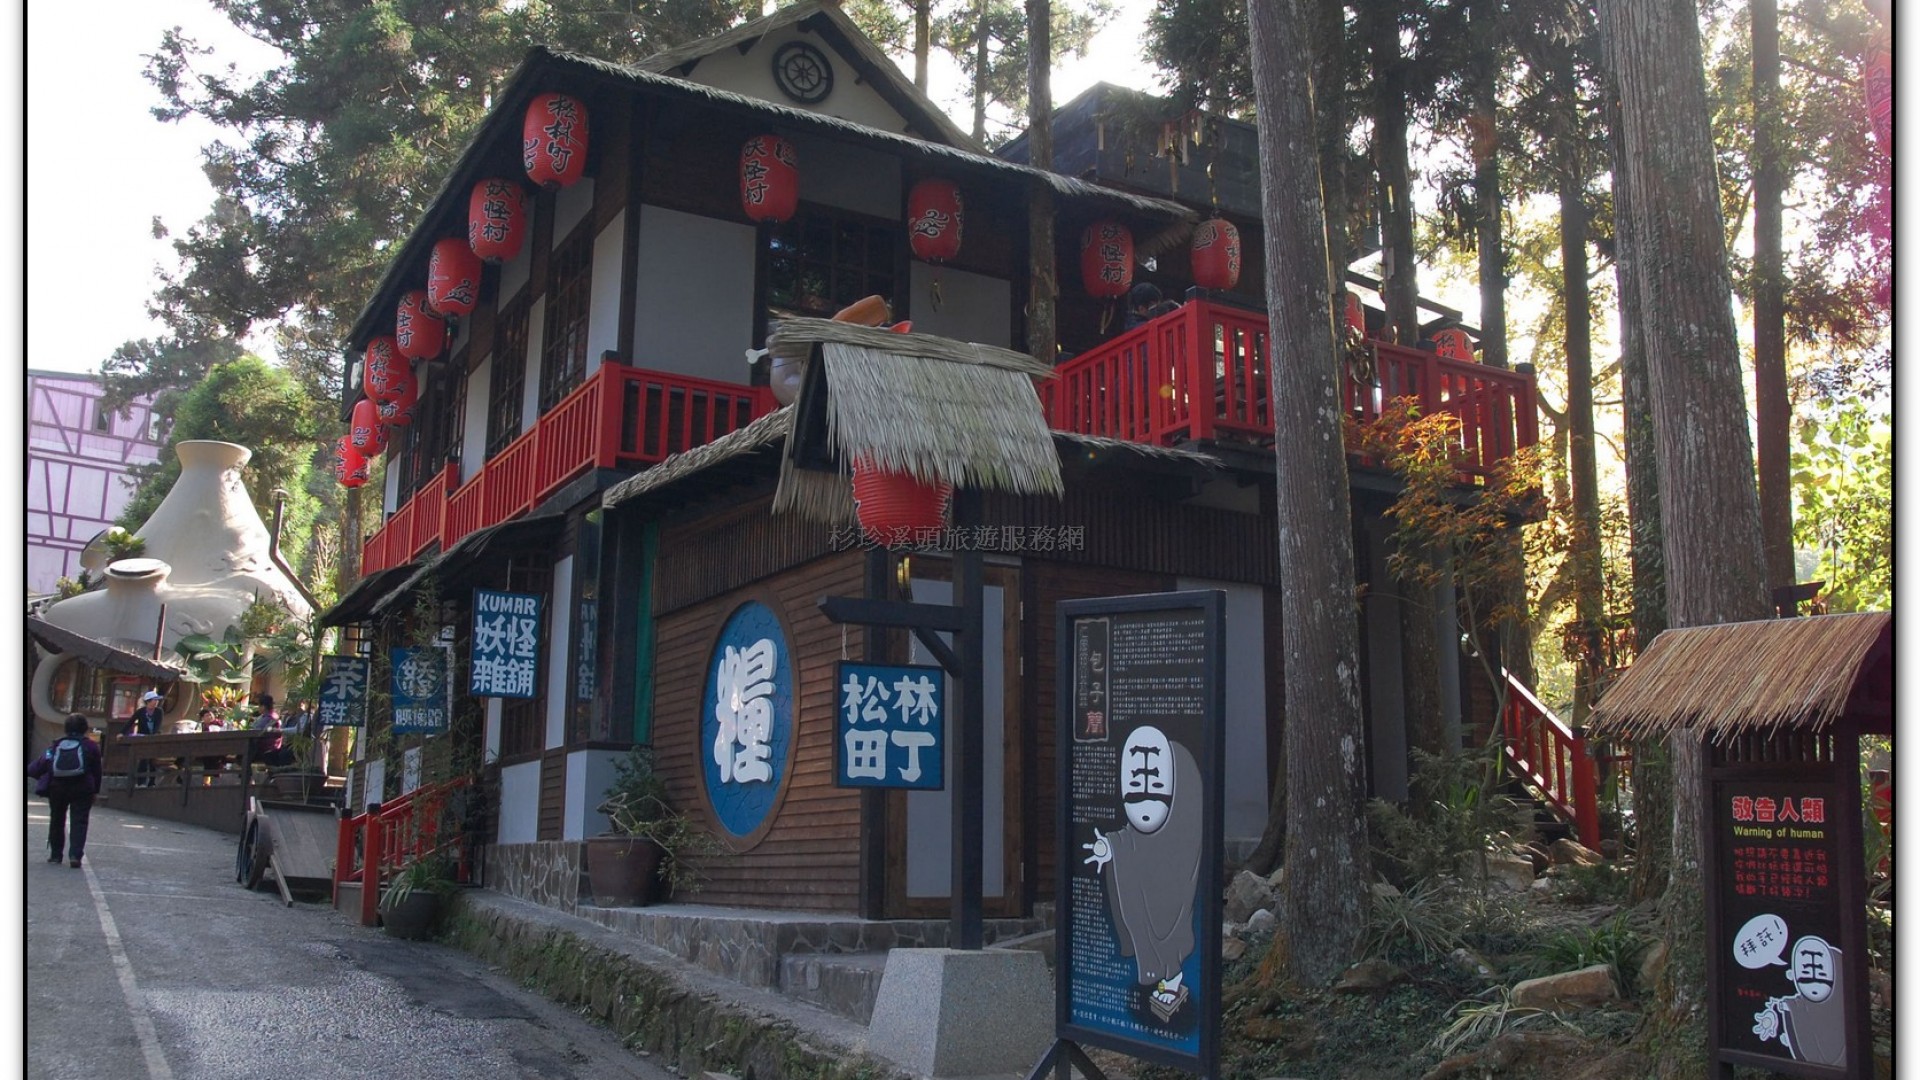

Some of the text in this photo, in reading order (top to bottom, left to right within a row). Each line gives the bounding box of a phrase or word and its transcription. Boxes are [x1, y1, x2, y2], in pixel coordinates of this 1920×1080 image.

[544, 95, 580, 174] 松林町
[482, 179, 512, 242] 妖怪村
[1101, 223, 1127, 284] 妖怪村
[478, 592, 537, 616] KUMAR
[474, 614, 537, 658] 妖怪
[323, 659, 365, 700] 茶
[1732, 796, 1825, 823] 敬告人類
[1733, 825, 1824, 840] Warning of human
